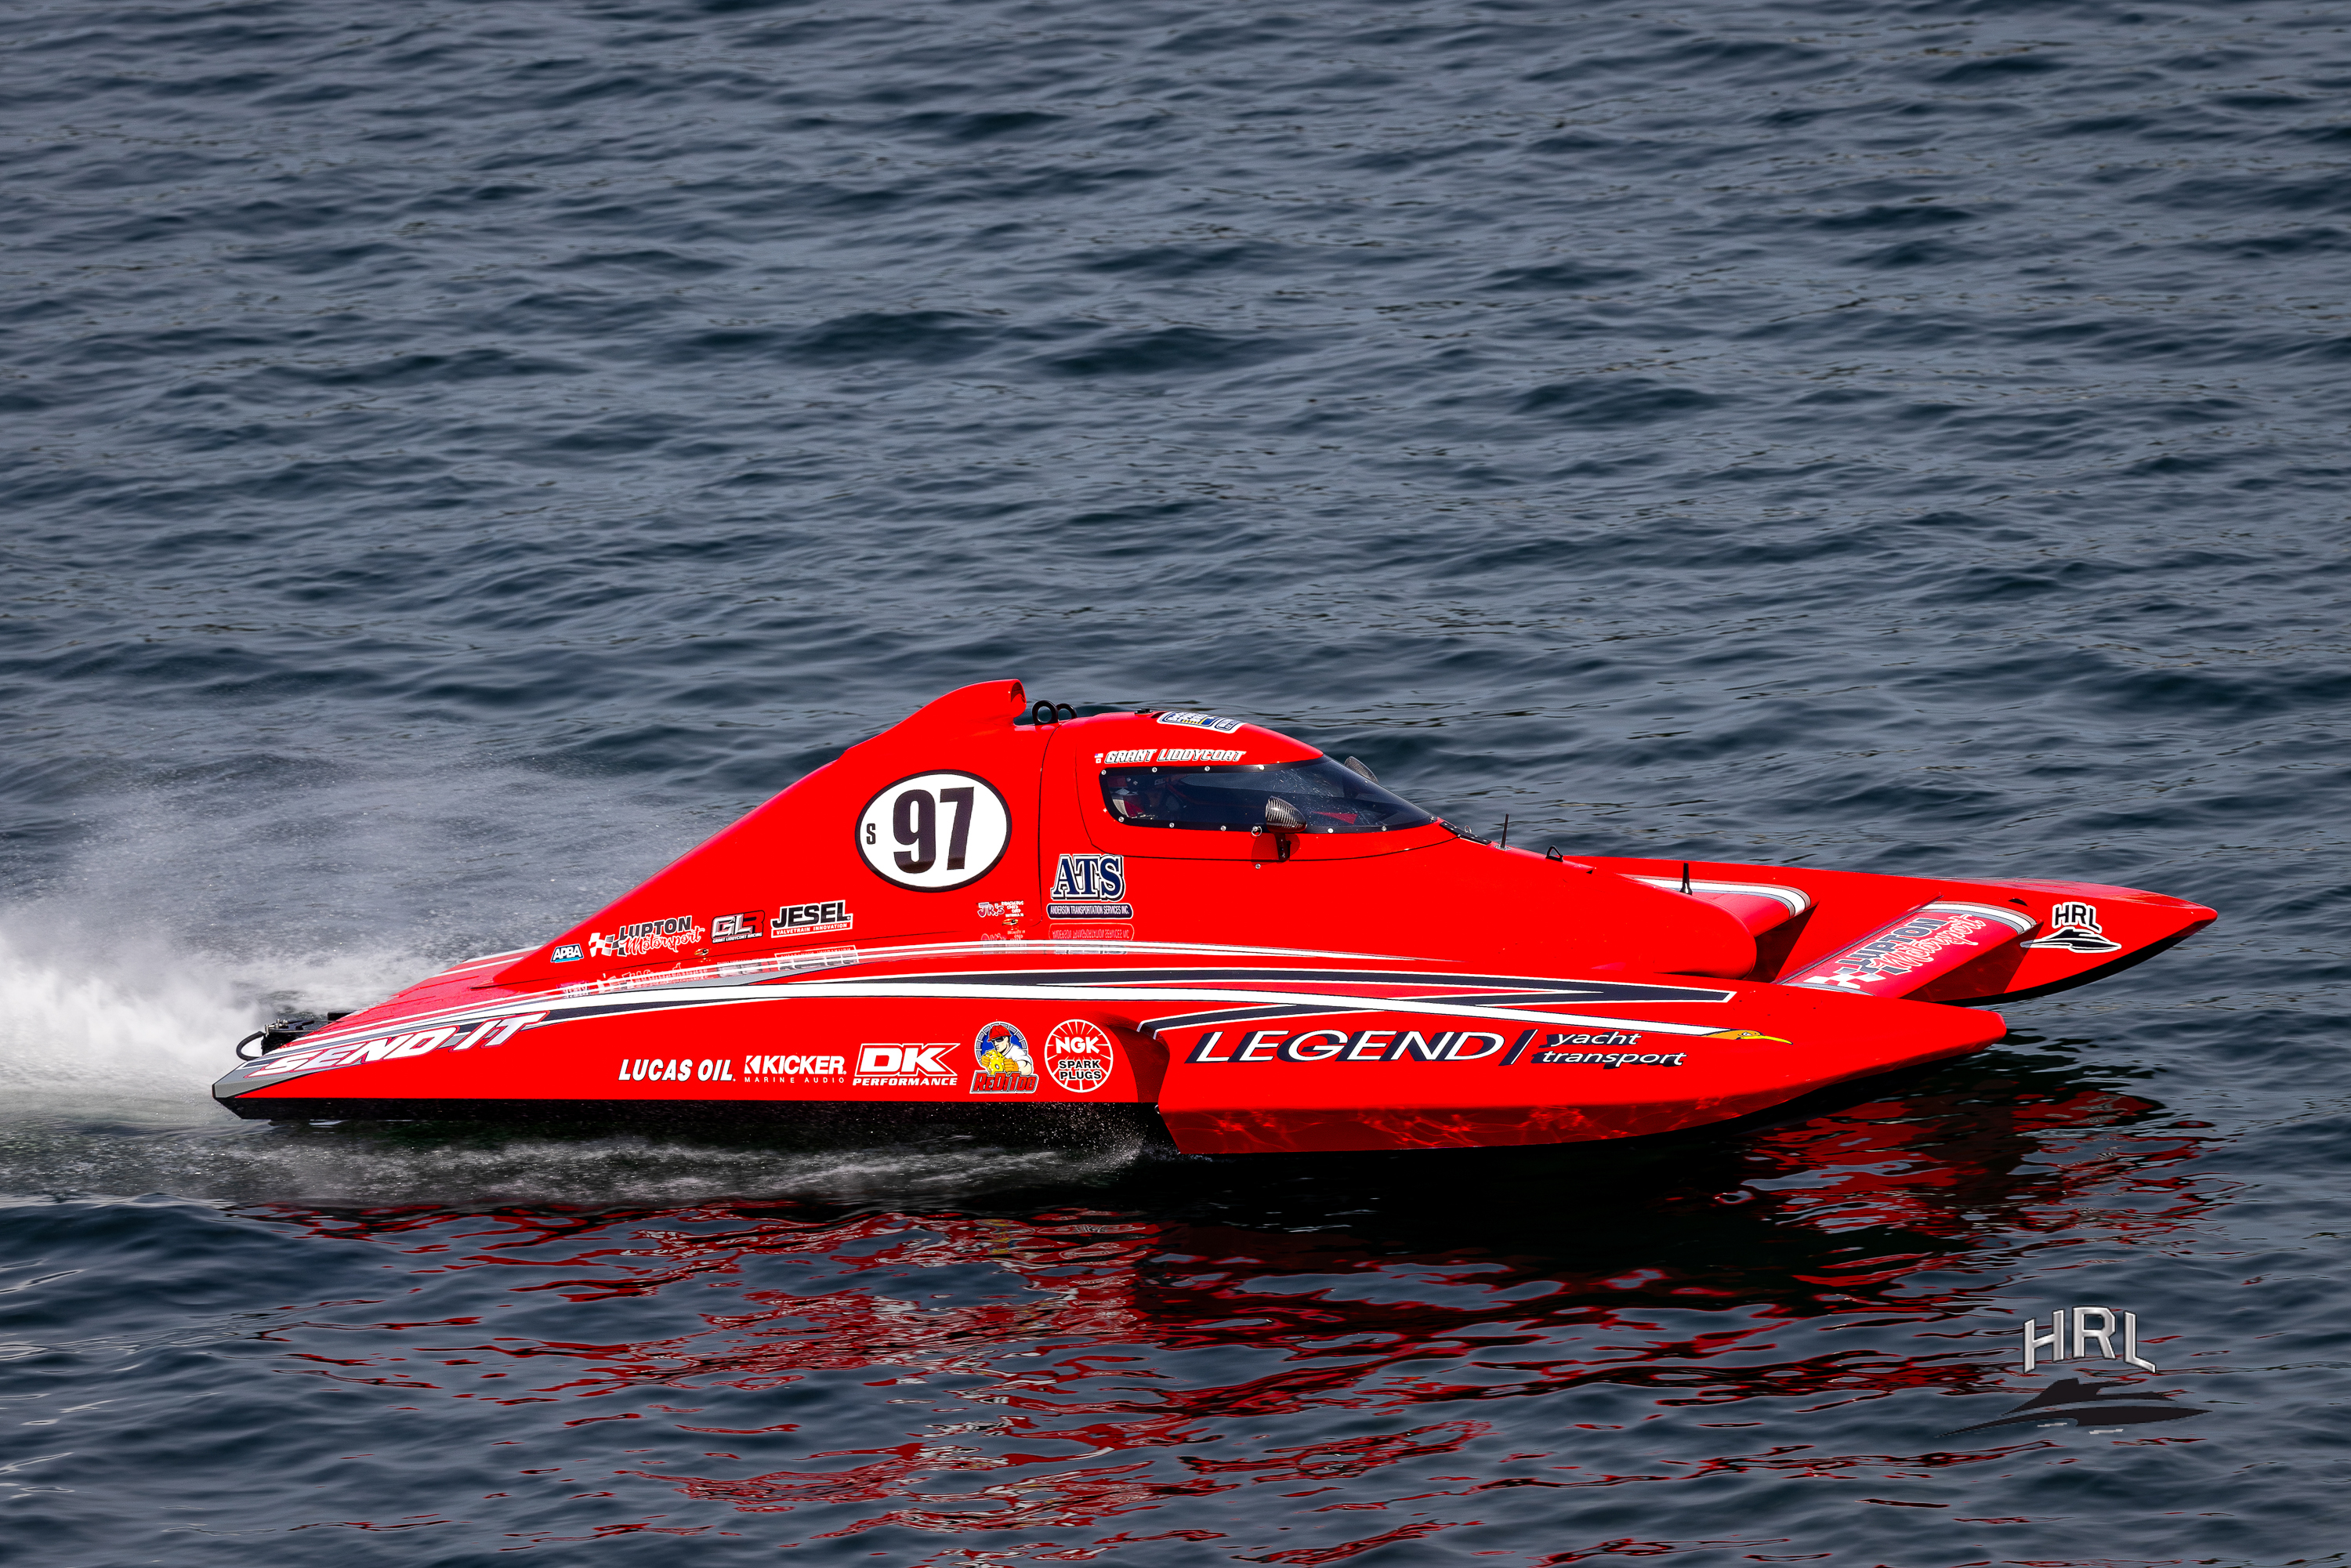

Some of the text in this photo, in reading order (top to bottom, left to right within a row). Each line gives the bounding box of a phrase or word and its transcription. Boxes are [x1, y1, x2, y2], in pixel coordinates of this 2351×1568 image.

[1104, 749, 1246, 763] GRANT LIDDYCOAT
[866, 786, 974, 874] S 97
[1051, 854, 1125, 901] ATS
[772, 900, 851, 929] JESEL
[1050, 905, 1070, 914] ANDERSON
[1070, 905, 1103, 914] TRANSPORTATION
[1103, 905, 1121, 914] SERVICES
[2053, 903, 2102, 932] HRL
[618, 915, 692, 940] LUPTON
[711, 910, 766, 939] GLR
[776, 923, 848, 936] VALVETRAIN INNOVATION
[620, 925, 705, 954] Motorsport
[1835, 918, 1950, 965] LUPTON
[1867, 914, 1987, 966] Motorsport
[552, 945, 582, 961] APBA
[245, 1010, 550, 1078] SEND IT
[1055, 1037, 1101, 1055] NGK
[1185, 1030, 1505, 1063] LEGEND
[1544, 1031, 1643, 1048] yacht
[618, 1059, 734, 1082] LUCAS OIL
[763, 1055, 846, 1075] KICKER
[857, 1043, 960, 1077] DK
[1059, 1060, 1101, 1069] SPARK
[1538, 1051, 1687, 1068] transport
[853, 1077, 958, 1086] PERFORMANCE
[1060, 1070, 1102, 1080] PLUGS
